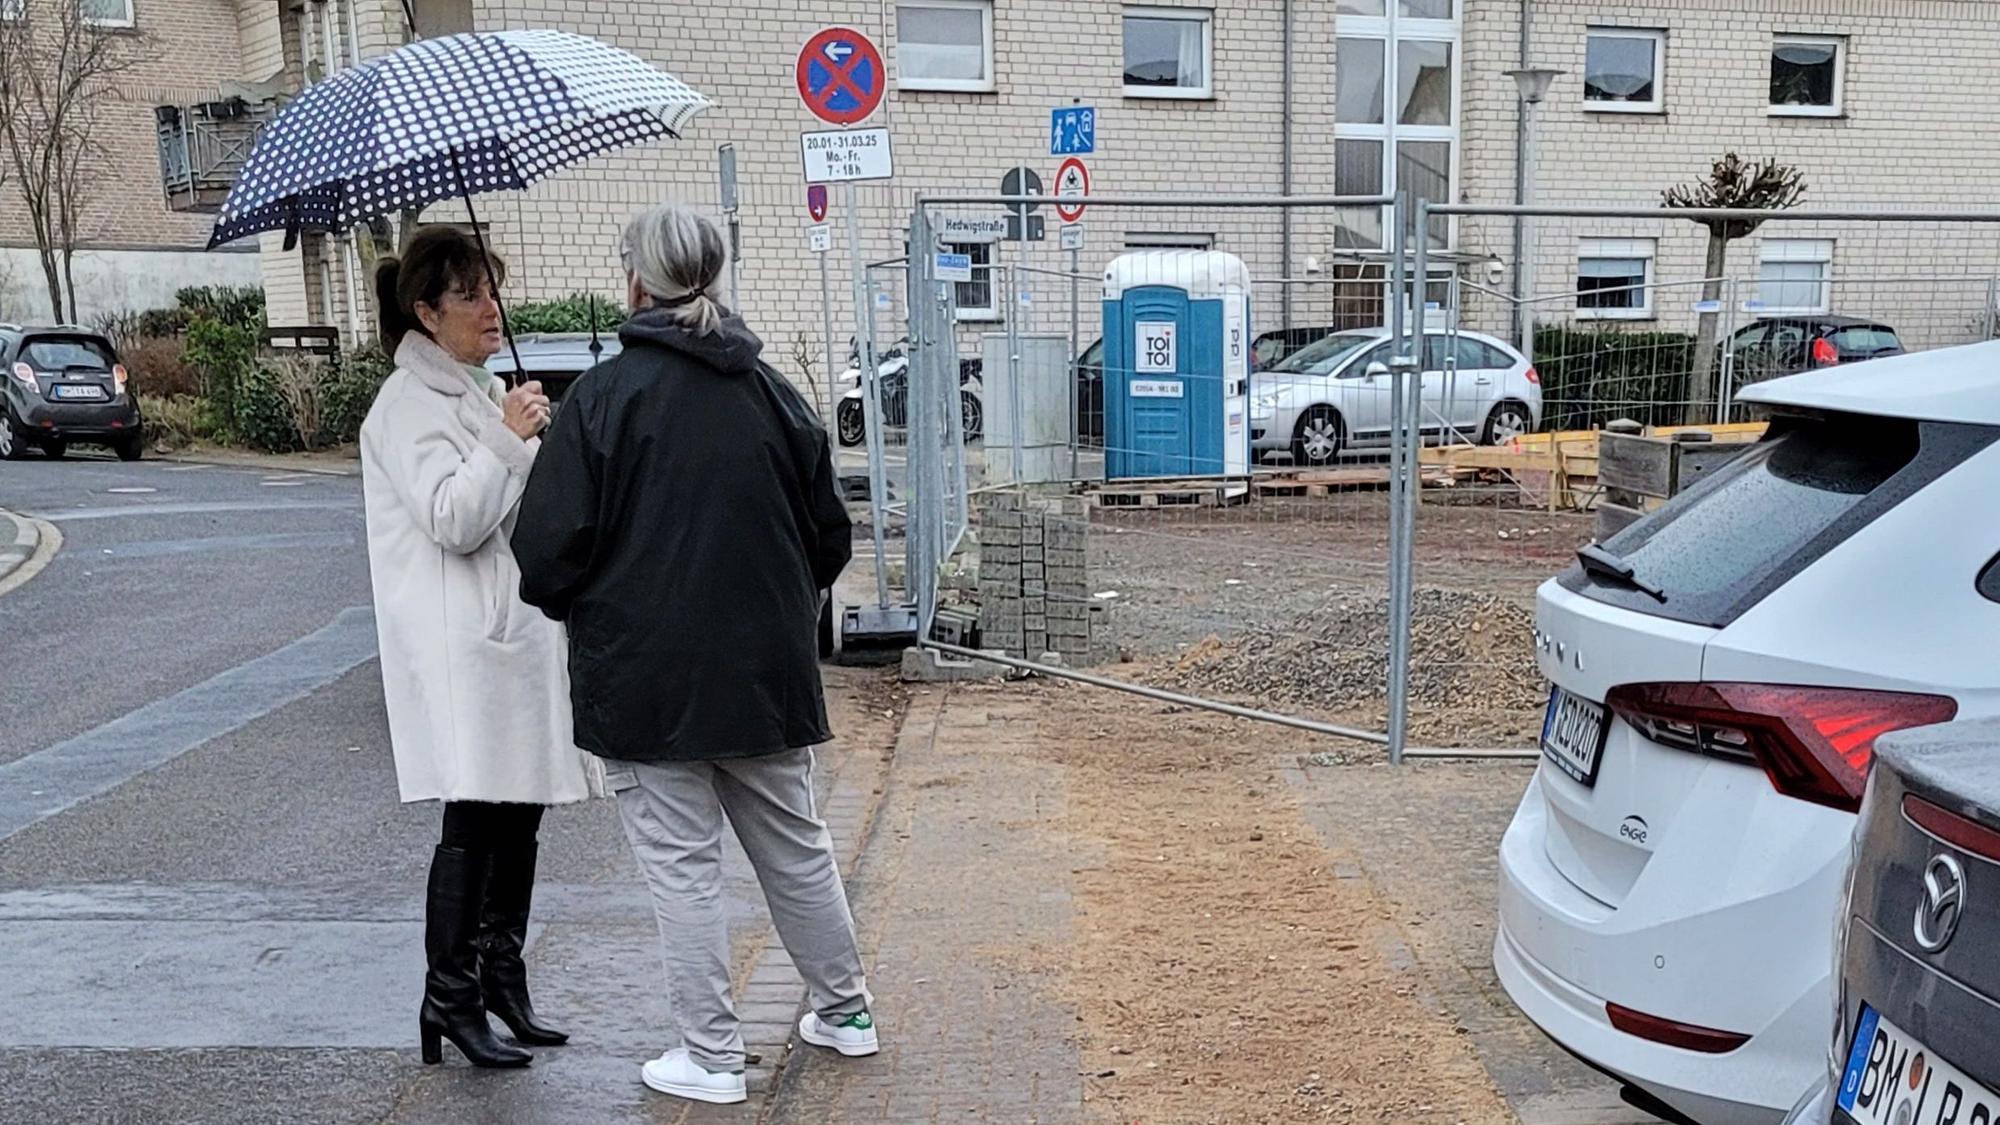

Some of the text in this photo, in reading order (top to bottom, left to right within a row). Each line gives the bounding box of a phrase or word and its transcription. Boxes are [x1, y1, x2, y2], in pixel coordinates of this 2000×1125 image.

[945, 217, 1005, 234] Hedwigstraße
[1146, 336, 1170, 351] TOI
[1146, 351, 1170, 366] TOI
[1857, 1027, 1909, 1125] BM
